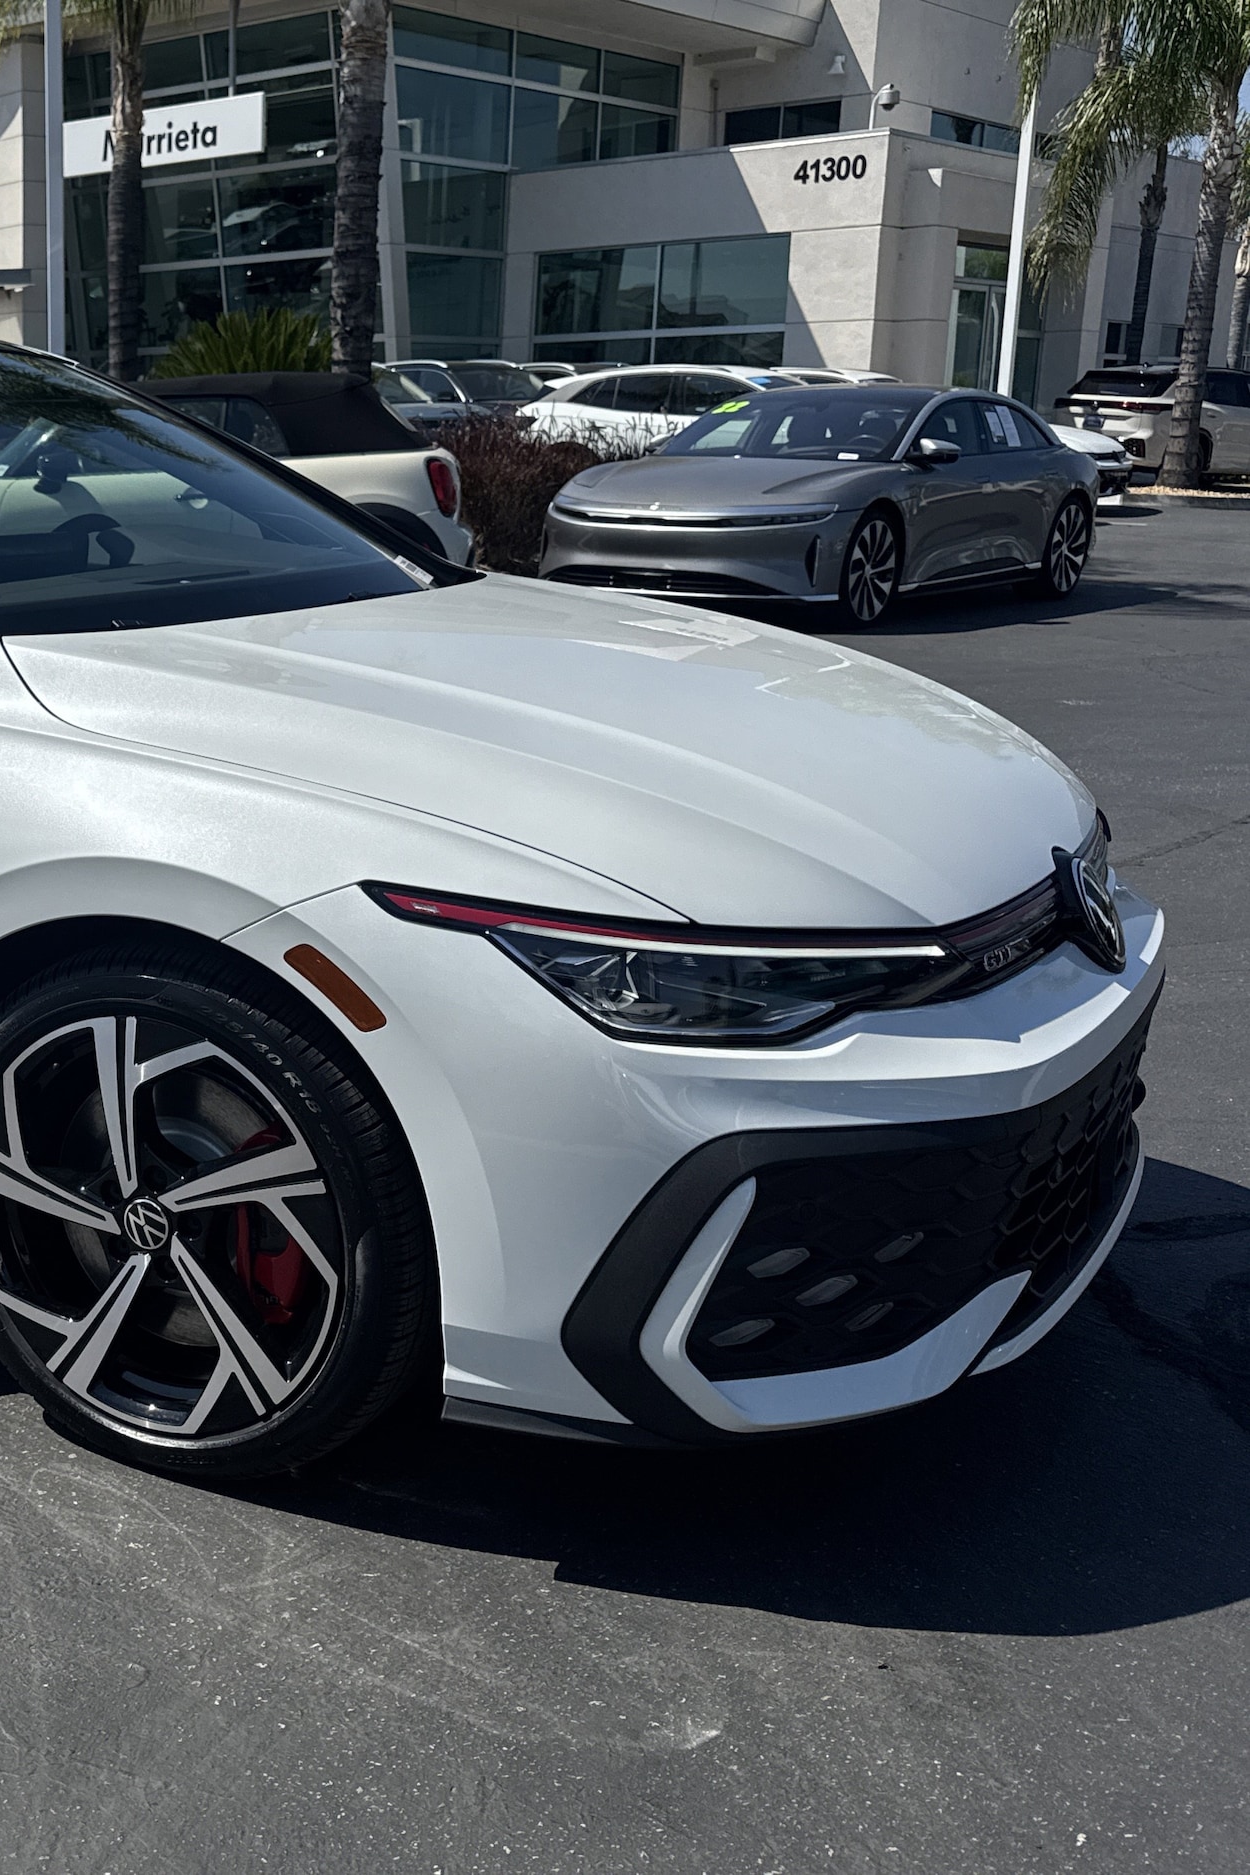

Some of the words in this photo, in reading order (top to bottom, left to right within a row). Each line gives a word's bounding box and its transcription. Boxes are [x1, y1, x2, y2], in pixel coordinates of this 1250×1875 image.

[102, 121, 217, 162] Mrrieta
[793, 154, 867, 184] 41300
[983, 944, 1012, 971] GTI
[124, 1200, 168, 1249] VW
